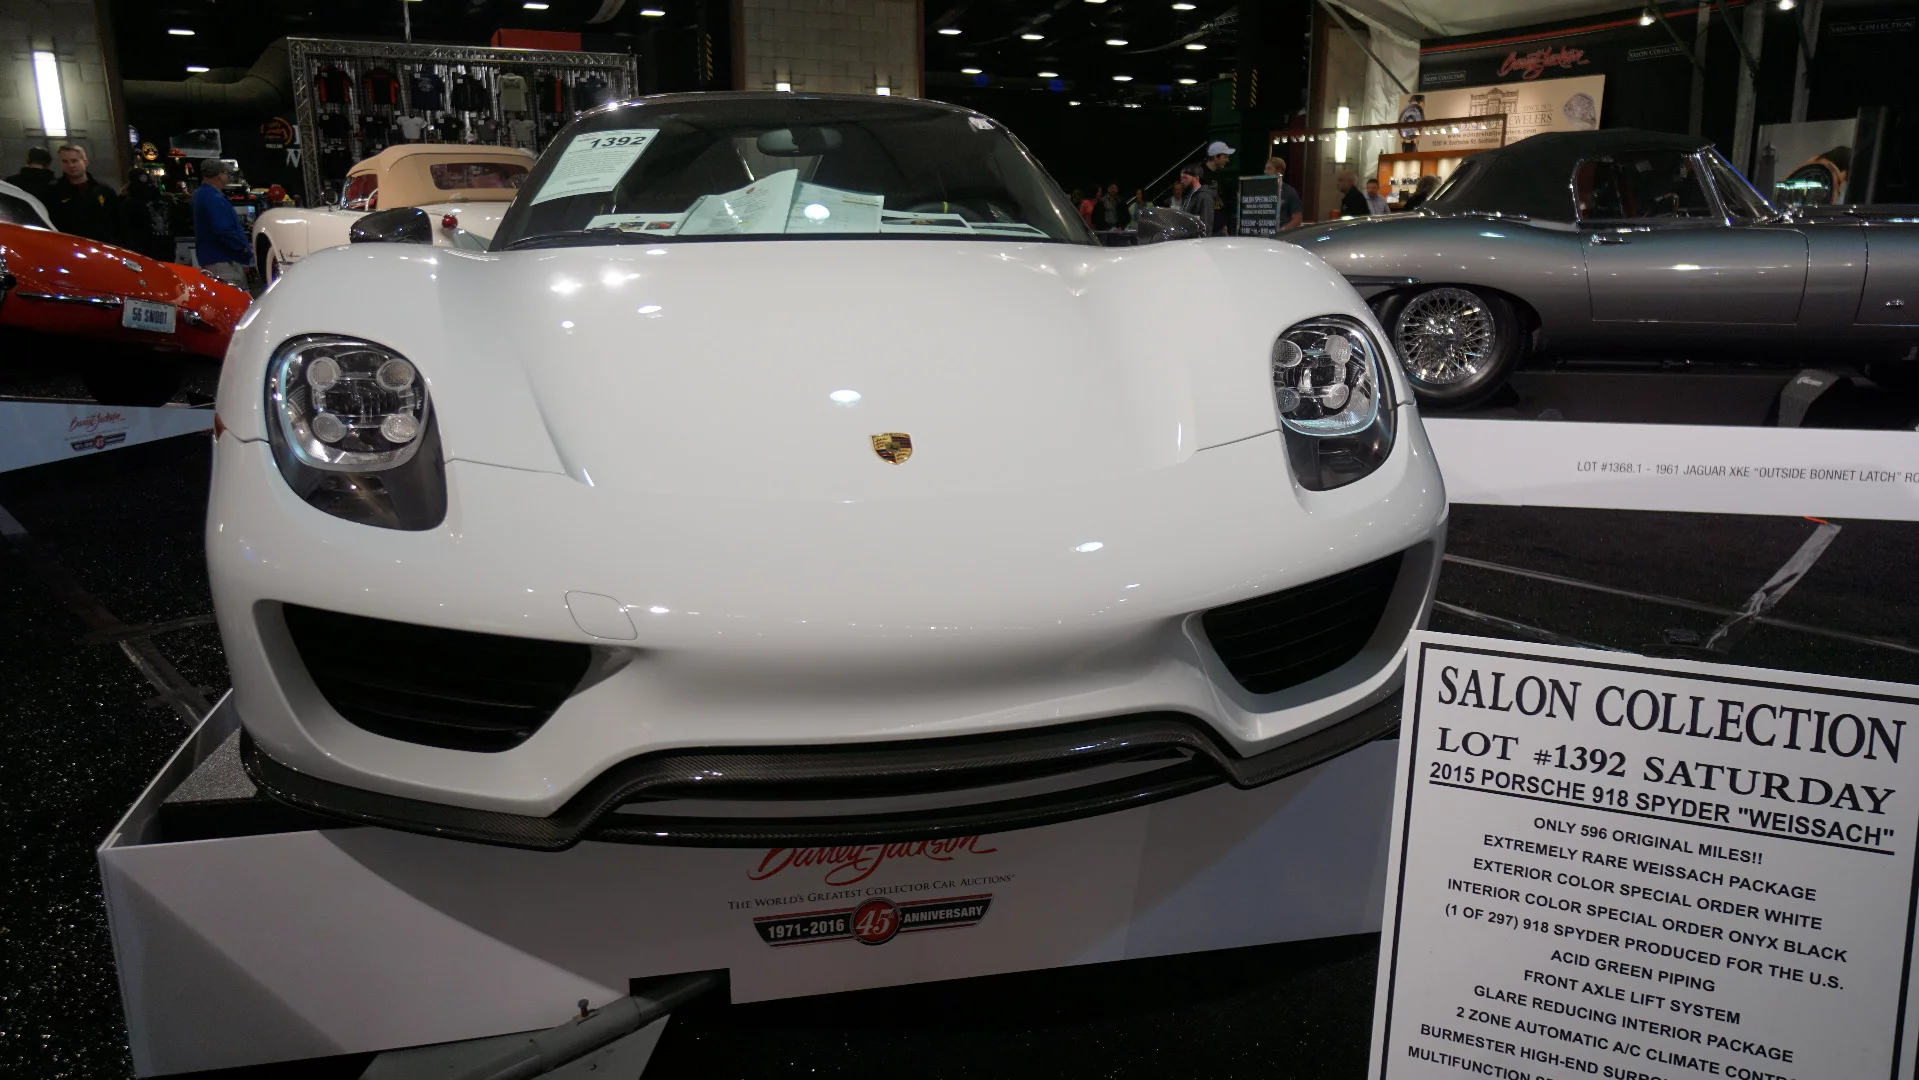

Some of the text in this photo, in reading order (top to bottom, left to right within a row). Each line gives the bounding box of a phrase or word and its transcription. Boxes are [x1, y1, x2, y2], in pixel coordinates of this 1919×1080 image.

[590, 136, 647, 149] 1392
[132, 307, 142, 321] 56
[1577, 461, 1598, 472] LOT
[1601, 462, 1642, 474] #1368.1
[1656, 464, 1679, 475] 1961
[1683, 464, 1727, 476] JAGUAR
[1729, 466, 1750, 478] XKE
[1754, 467, 1807, 479] "OUTSIDE
[1809, 468, 1857, 481] BONNET
[1859, 470, 1902, 482] LATCH"
[1438, 665, 1907, 763] SALON COLLECTION
[1436, 727, 1896, 815] LOT #1392 SATURDAY
[1429, 761, 1894, 846] 2015 PORSCHE 918 SPYDER "WEISSACH"
[1484, 834, 1816, 901] EXTREMELY RARE WEISSACH PACKAGE
[1534, 817, 1762, 865] ONLY 596 ORIGINAL MILES!!
[727, 900, 752, 910] THE
[752, 894, 805, 908] WORLD'S
[807, 889, 863, 902] GREATEST
[866, 883, 930, 897] COLLECTOR
[933, 880, 956, 889] CAR
[1448, 878, 1847, 963] INTERIOR COLOR SPECIAL ORDER ONYX BLACK
[1473, 857, 1822, 930] EXTERIOR COLOR SPECIAL ORDER WHITE
[768, 919, 845, 939] 1971-2016
[904, 905, 984, 924] ANNIVERSARY
[1445, 903, 1843, 990] (1 OF 297) 918 SPYDER PRODUCED FOR THE U.S.
[1524, 969, 1740, 1025] FRONT AXLE LIFT SYSTEM
[1550, 950, 1715, 992] ACID GREEN PIPING
[1420, 1023, 1515, 1056] BURMESTER
[1520, 1046, 1598, 1074] HIGH-END
[1456, 1006, 1465, 1018] 2
[1468, 1009, 1511, 1029] ZONE
[1514, 1020, 1608, 1050] AUTOMATIC
[1612, 1041, 1641, 1057] A/C
[1646, 1048, 1720, 1075] CLIMATE
[1474, 985, 1793, 1063] GLARE REDUCING INTERIOR PACKAGE
[1408, 1045, 1530, 1080] MULTIFUNCTION
